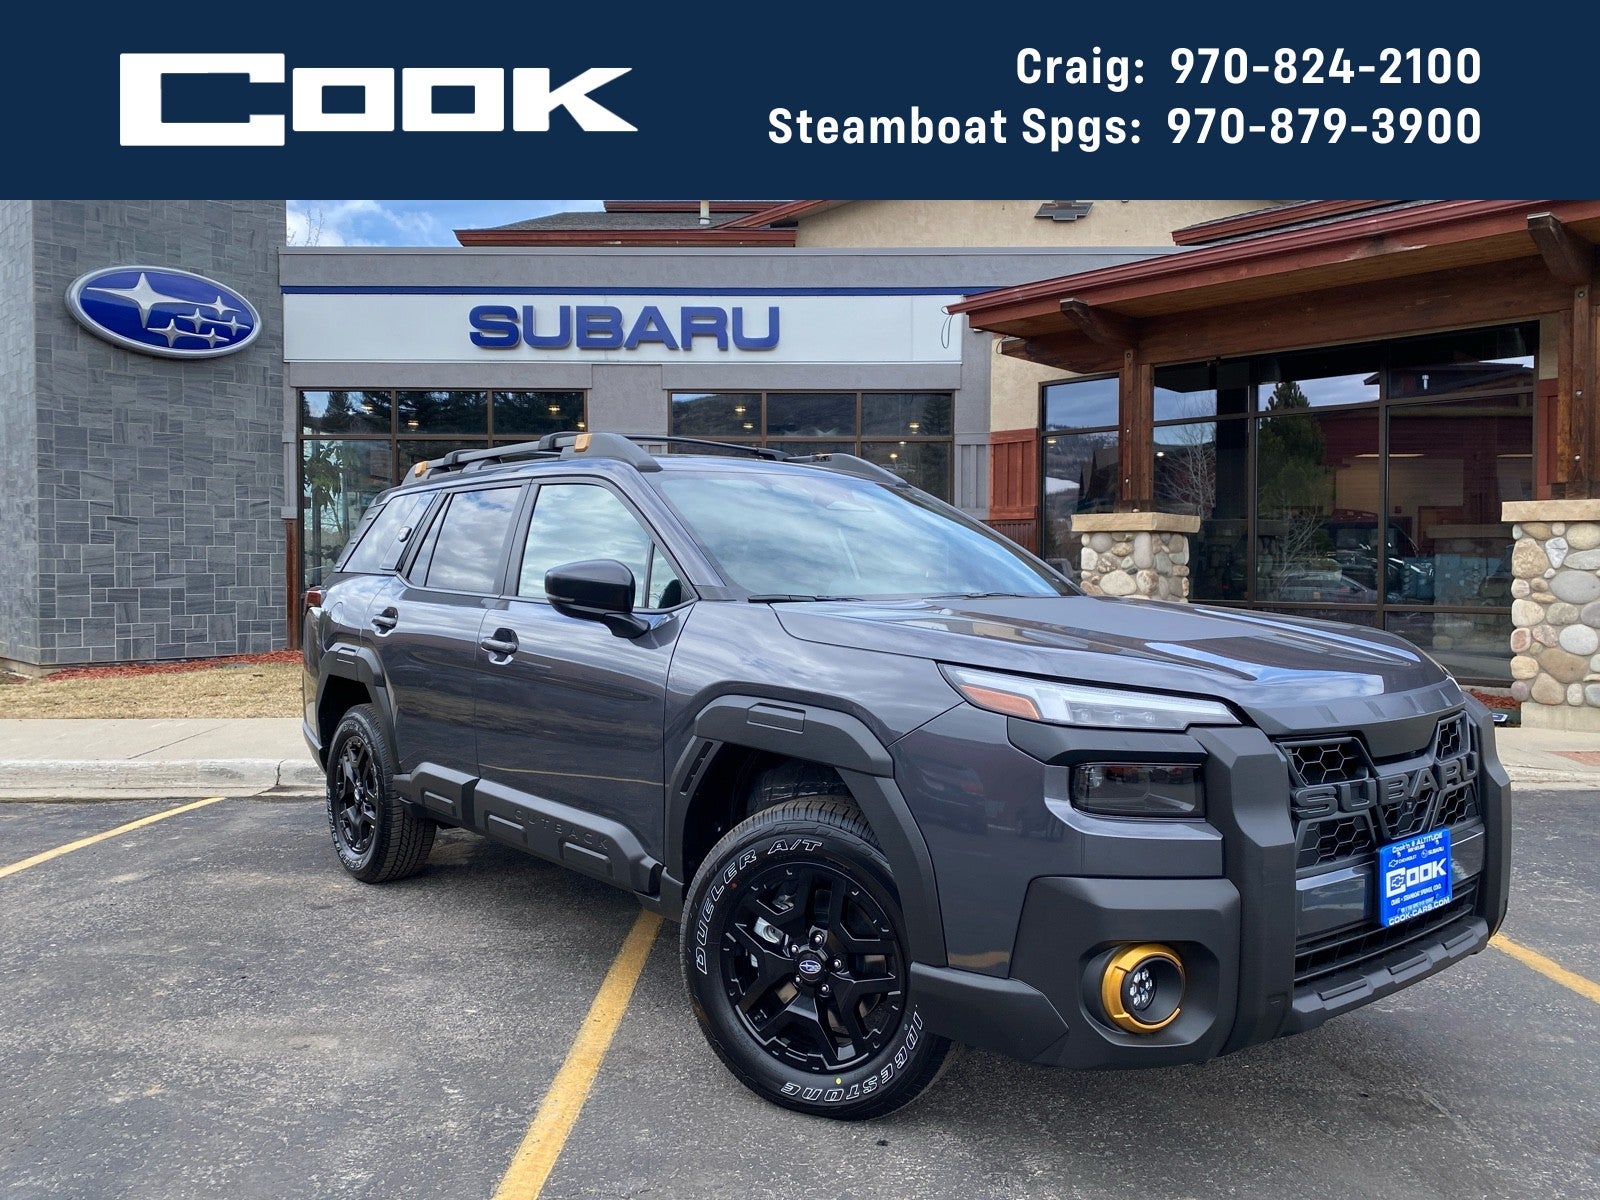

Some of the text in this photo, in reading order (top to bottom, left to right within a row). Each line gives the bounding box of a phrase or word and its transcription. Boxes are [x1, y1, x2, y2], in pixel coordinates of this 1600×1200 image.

[469, 305, 780, 350] SUBARU
[1294, 751, 1479, 819] SUBARU
[695, 839, 823, 975] DUELER A/T
[1386, 858, 1447, 898] COOK
[780, 1011, 923, 1102] IDGESTONE
